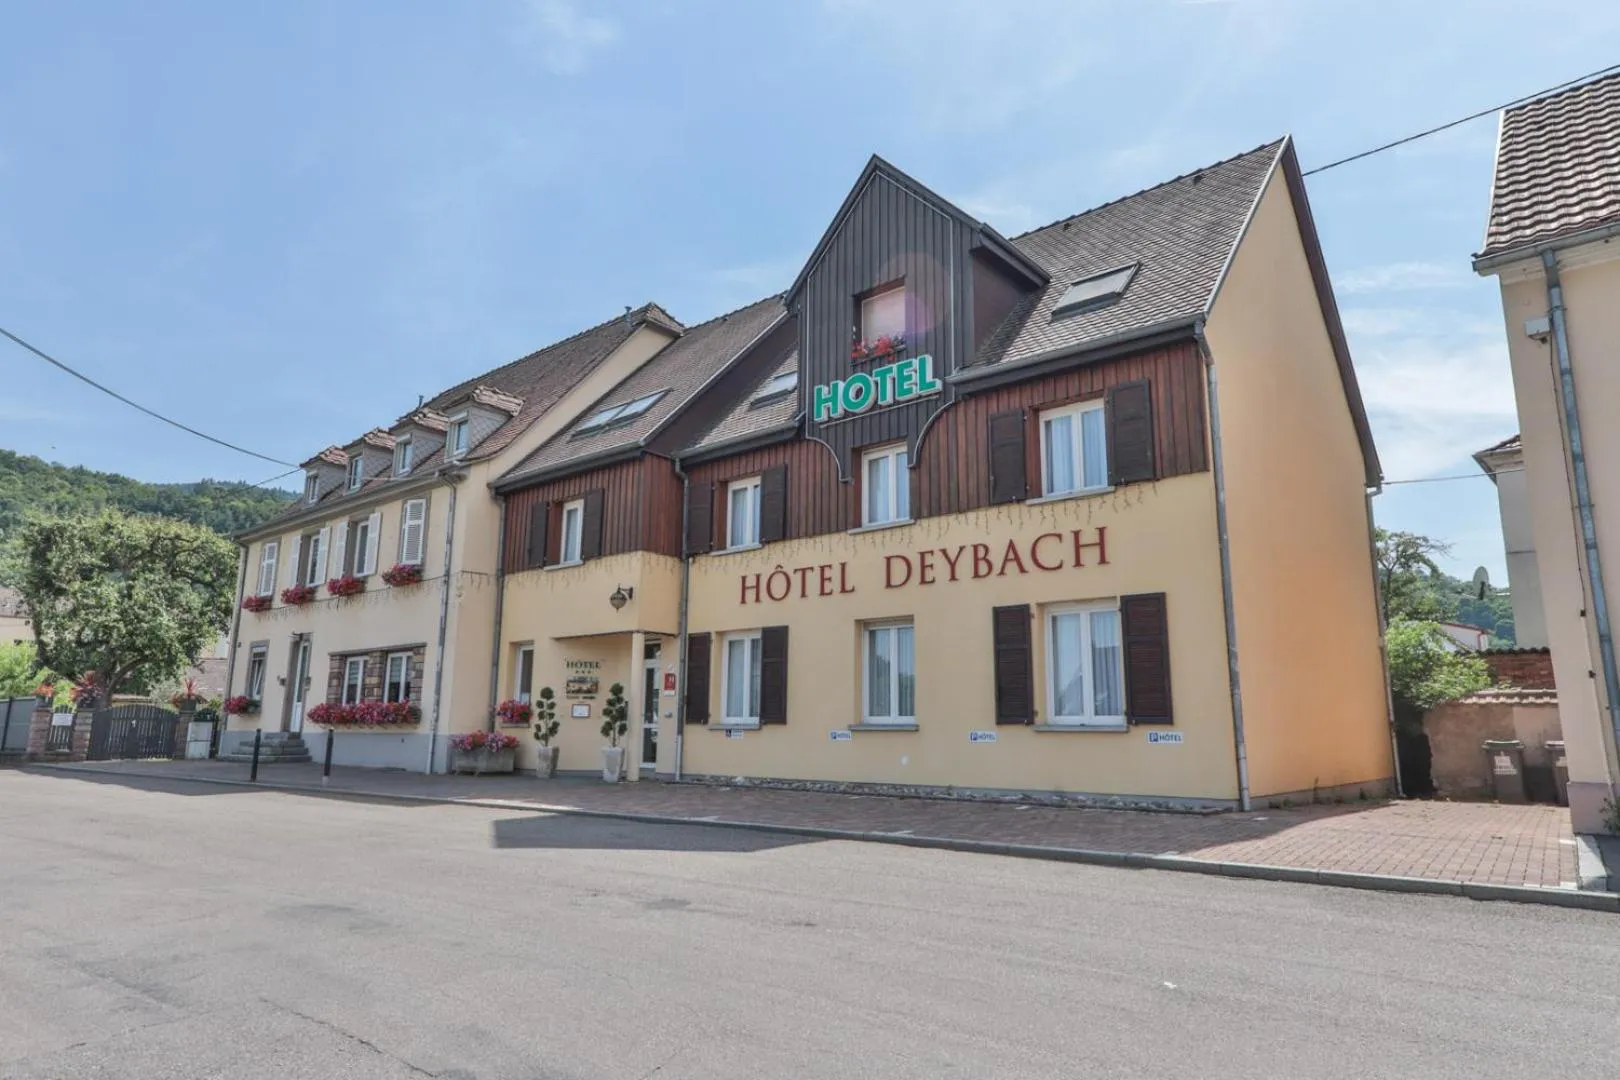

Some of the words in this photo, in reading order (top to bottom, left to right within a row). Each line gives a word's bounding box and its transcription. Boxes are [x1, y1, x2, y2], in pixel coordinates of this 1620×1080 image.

[814, 354, 943, 421] HOTEL
[740, 562, 855, 604] HÔTEL
[884, 526, 1110, 589] DEYBACH
